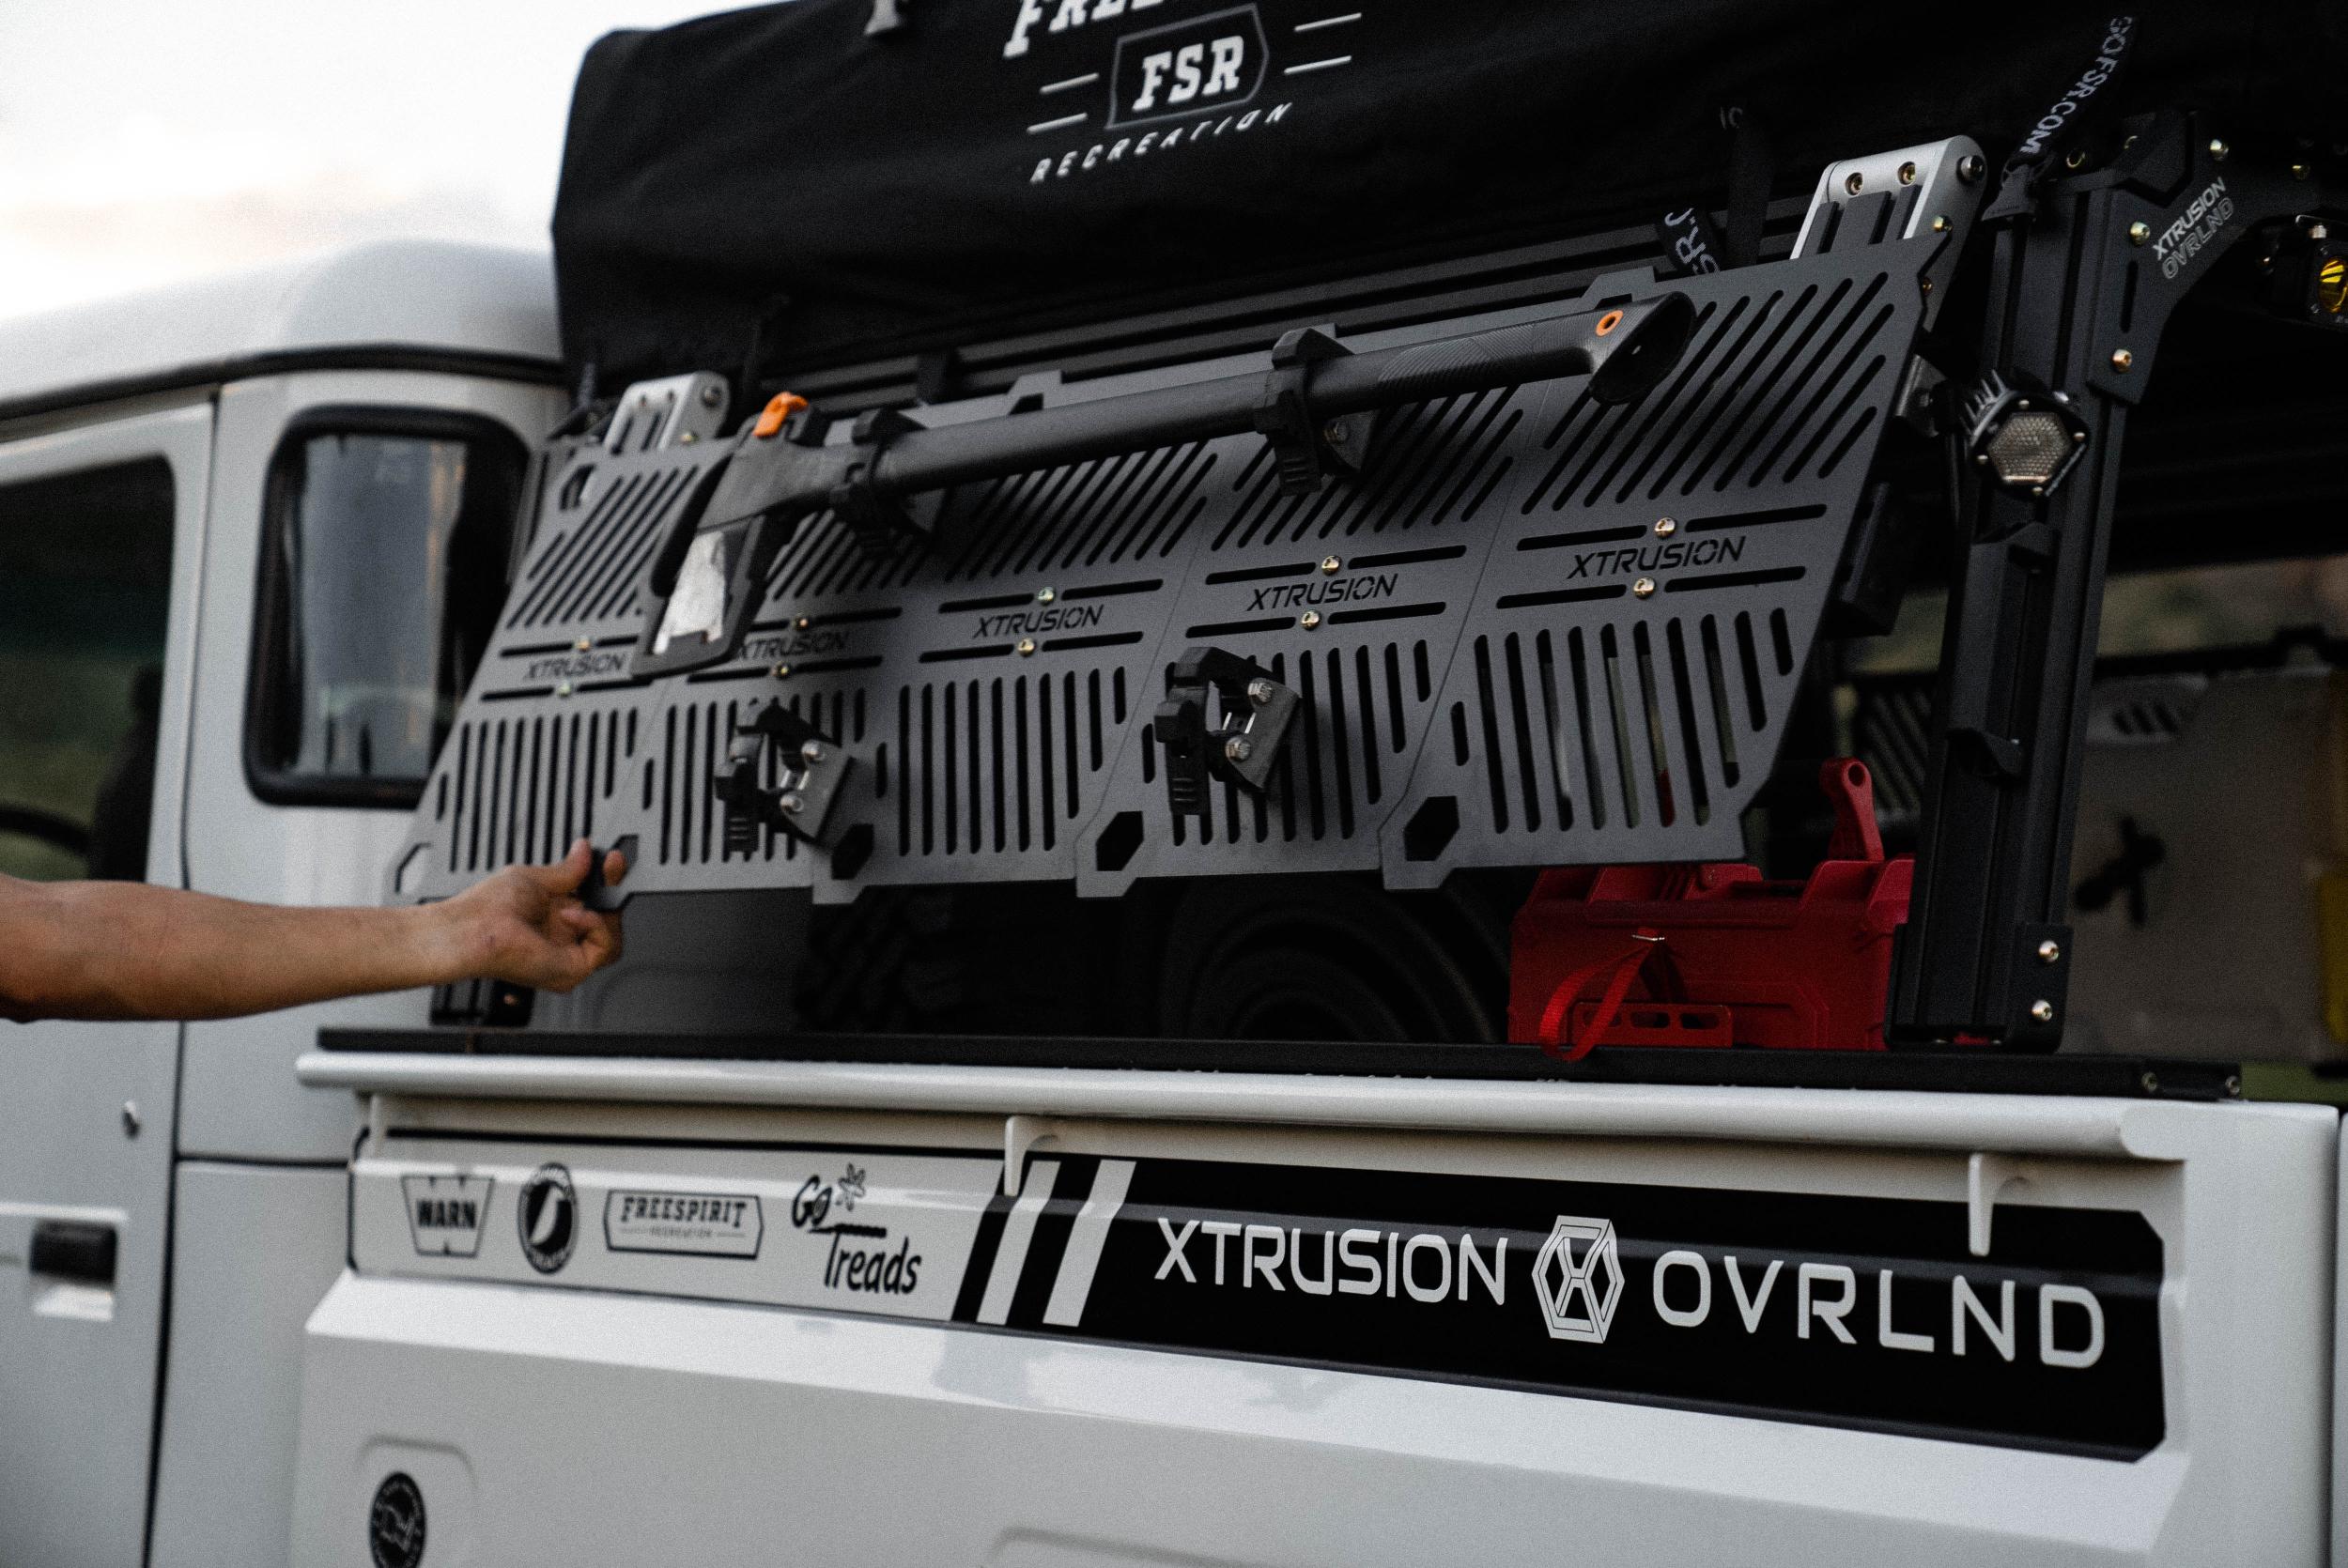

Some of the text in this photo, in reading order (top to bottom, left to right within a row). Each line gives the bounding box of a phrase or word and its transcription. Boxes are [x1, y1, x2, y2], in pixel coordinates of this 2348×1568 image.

[1131, 35, 1245, 113] FSR
[1029, 101, 1294, 184] RECREATION
[2152, 176, 2227, 261] XTRUSION
[2162, 196, 2234, 280] OVRLND
[1246, 573, 1399, 612] XTRUSION
[1567, 535, 1747, 580] XTRUSION
[972, 604, 1105, 639] XTRUSION
[621, 1196, 748, 1229] FREESPIRIT
[792, 1174, 833, 1229] Go
[809, 1222, 922, 1295] Treads
[1154, 1217, 2106, 1369] XTRUSION OVRLND
